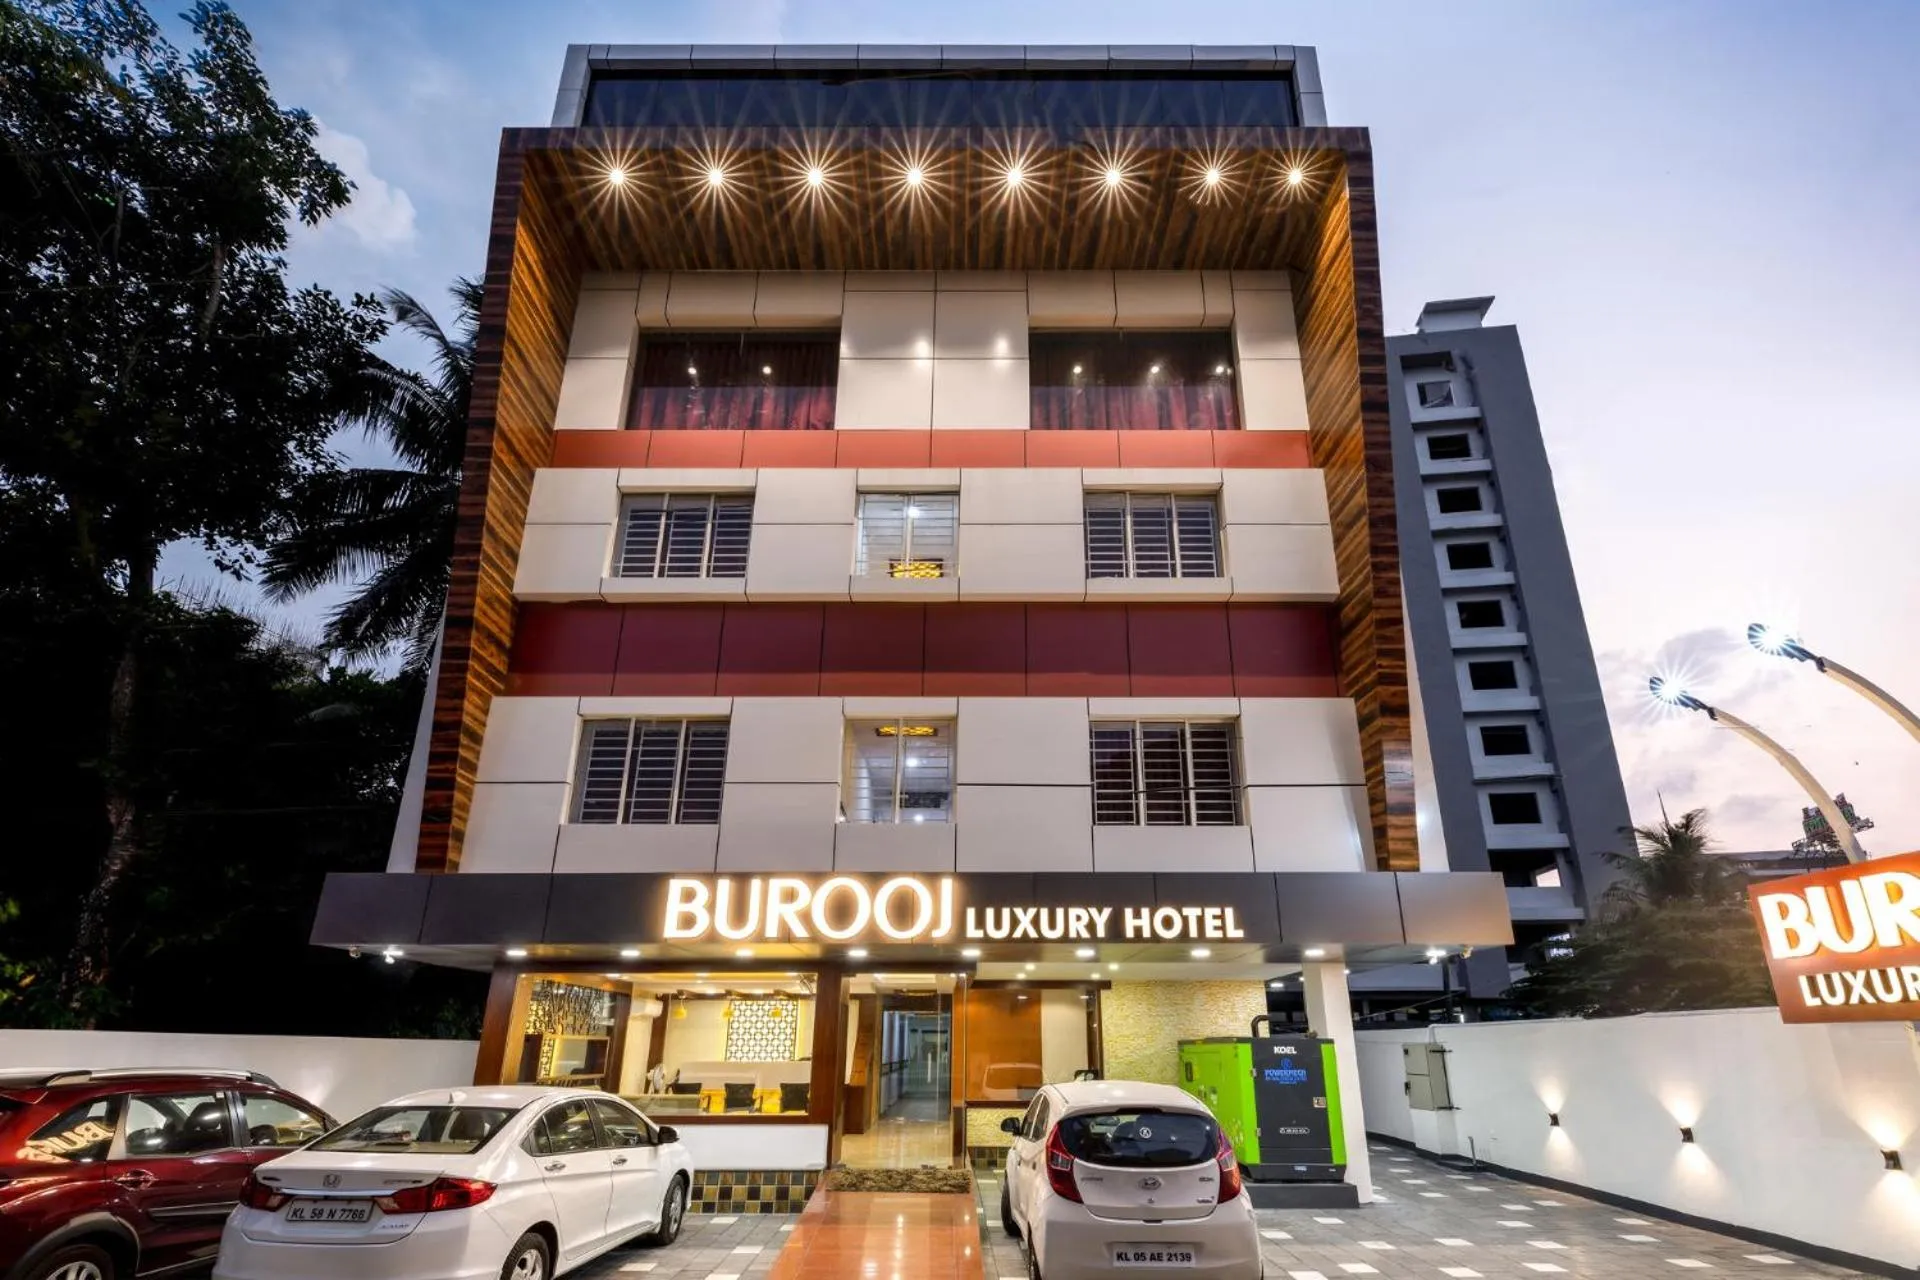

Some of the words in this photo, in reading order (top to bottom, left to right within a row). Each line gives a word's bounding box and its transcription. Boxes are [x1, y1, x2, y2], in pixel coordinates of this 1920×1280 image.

[663, 877, 954, 939] BUROOJ
[965, 907, 1113, 939] LUXURY
[1124, 907, 1245, 939] HOTEL
[1757, 872, 1920, 959] BUR
[291, 1208, 305, 1219] KL
[327, 1208, 337, 1219] N
[1116, 1252, 1131, 1262] KL
[1133, 1252, 1147, 1262] 05
[1149, 1252, 1164, 1262] AE
